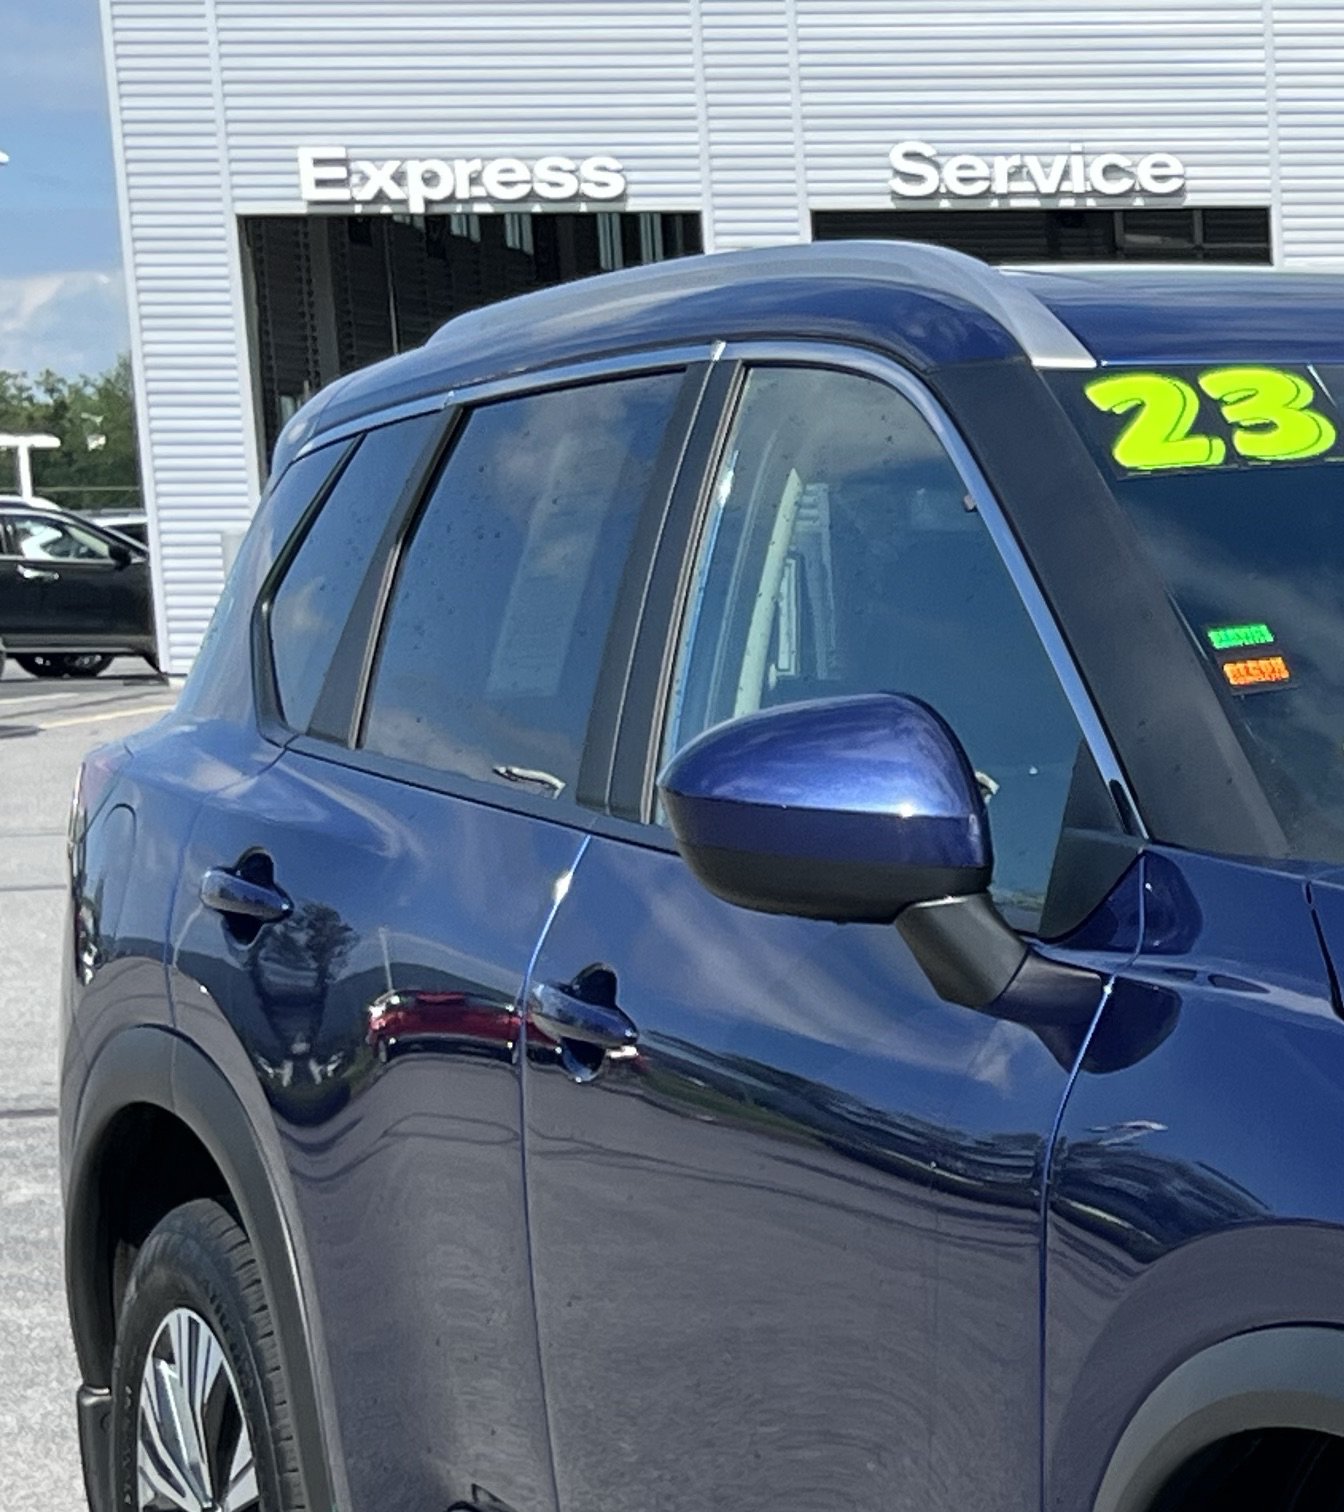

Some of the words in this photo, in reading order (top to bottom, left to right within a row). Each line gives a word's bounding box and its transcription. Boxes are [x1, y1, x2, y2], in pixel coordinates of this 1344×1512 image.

[298, 146, 626, 214] Express
[889, 141, 1186, 197] Service
[1085, 367, 1336, 470] 23
